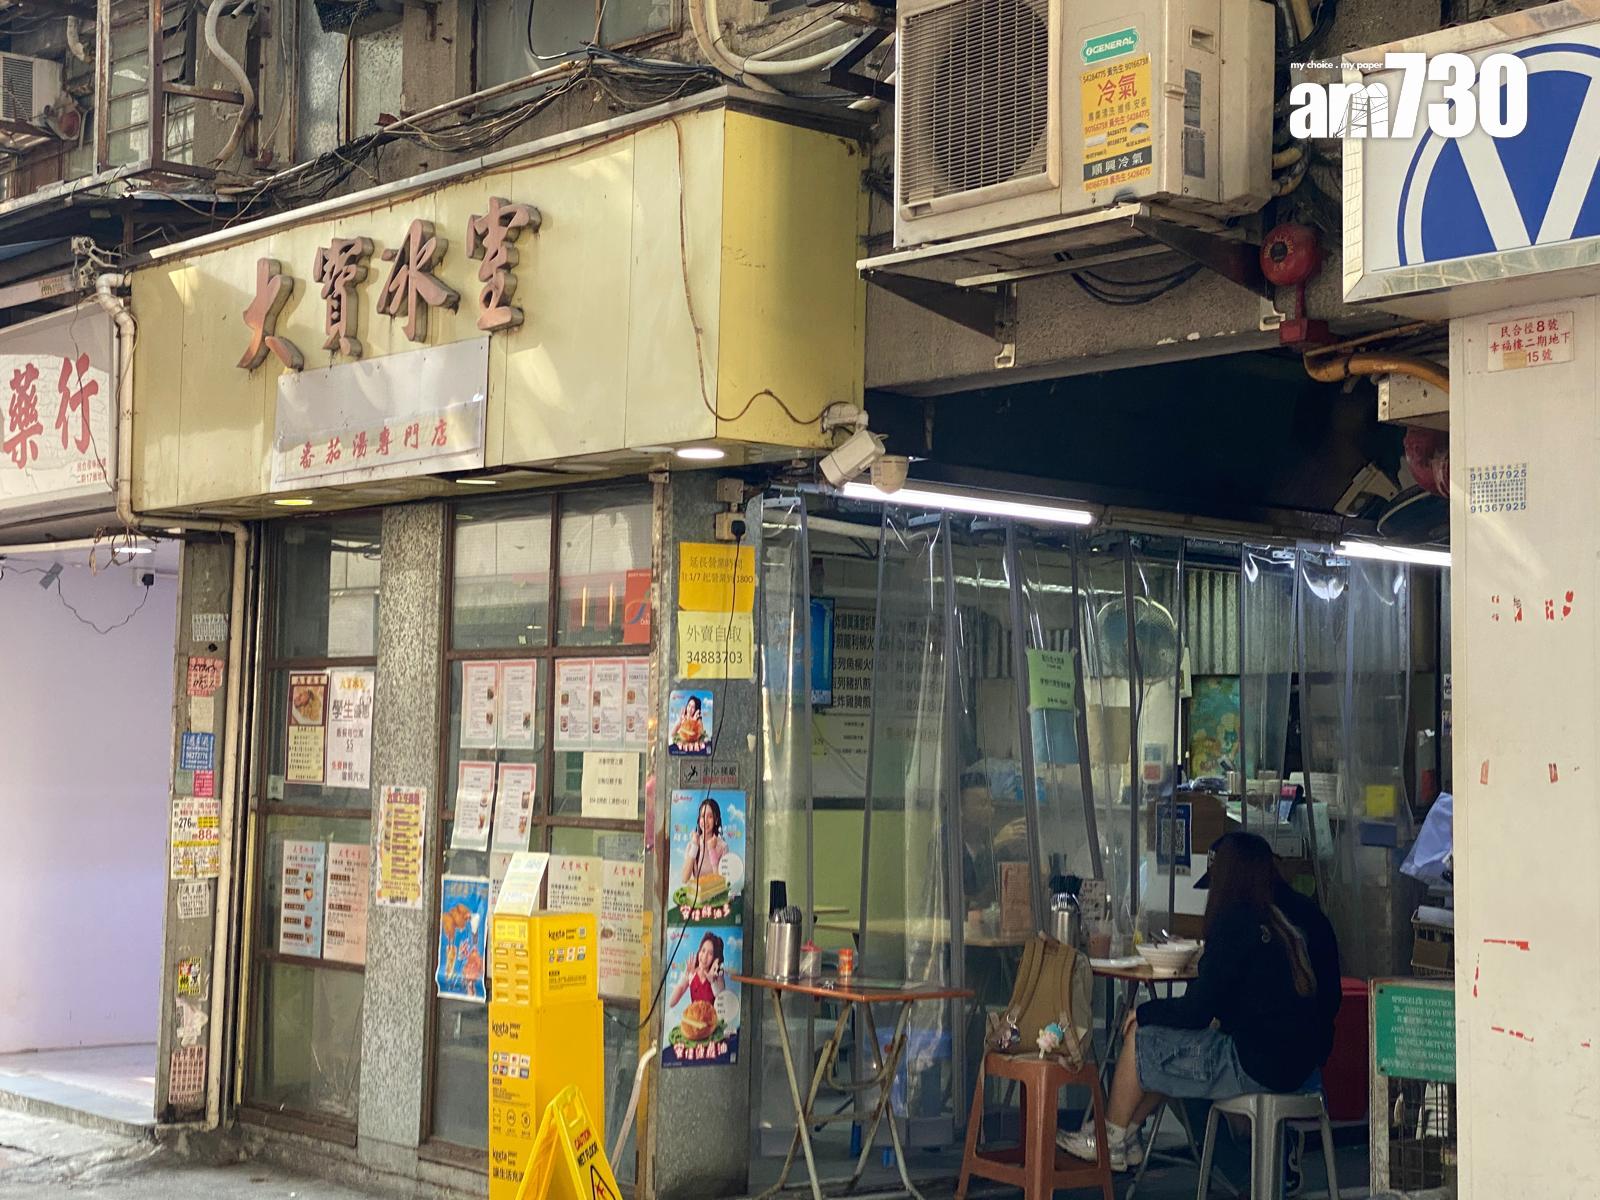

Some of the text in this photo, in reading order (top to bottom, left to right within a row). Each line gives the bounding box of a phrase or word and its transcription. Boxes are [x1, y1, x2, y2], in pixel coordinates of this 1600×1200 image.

[1097, 72, 1138, 106] 冷氣
[1527, 348, 1553, 362] 15號
[2, 352, 99, 470] 藥行
[299, 418, 448, 470] 番茄湯專門店
[1470, 469, 1527, 481] 91367925
[1470, 502, 1527, 513] 91367925
[687, 624, 742, 643] 外賣自取
[687, 651, 743, 664] 34883703
